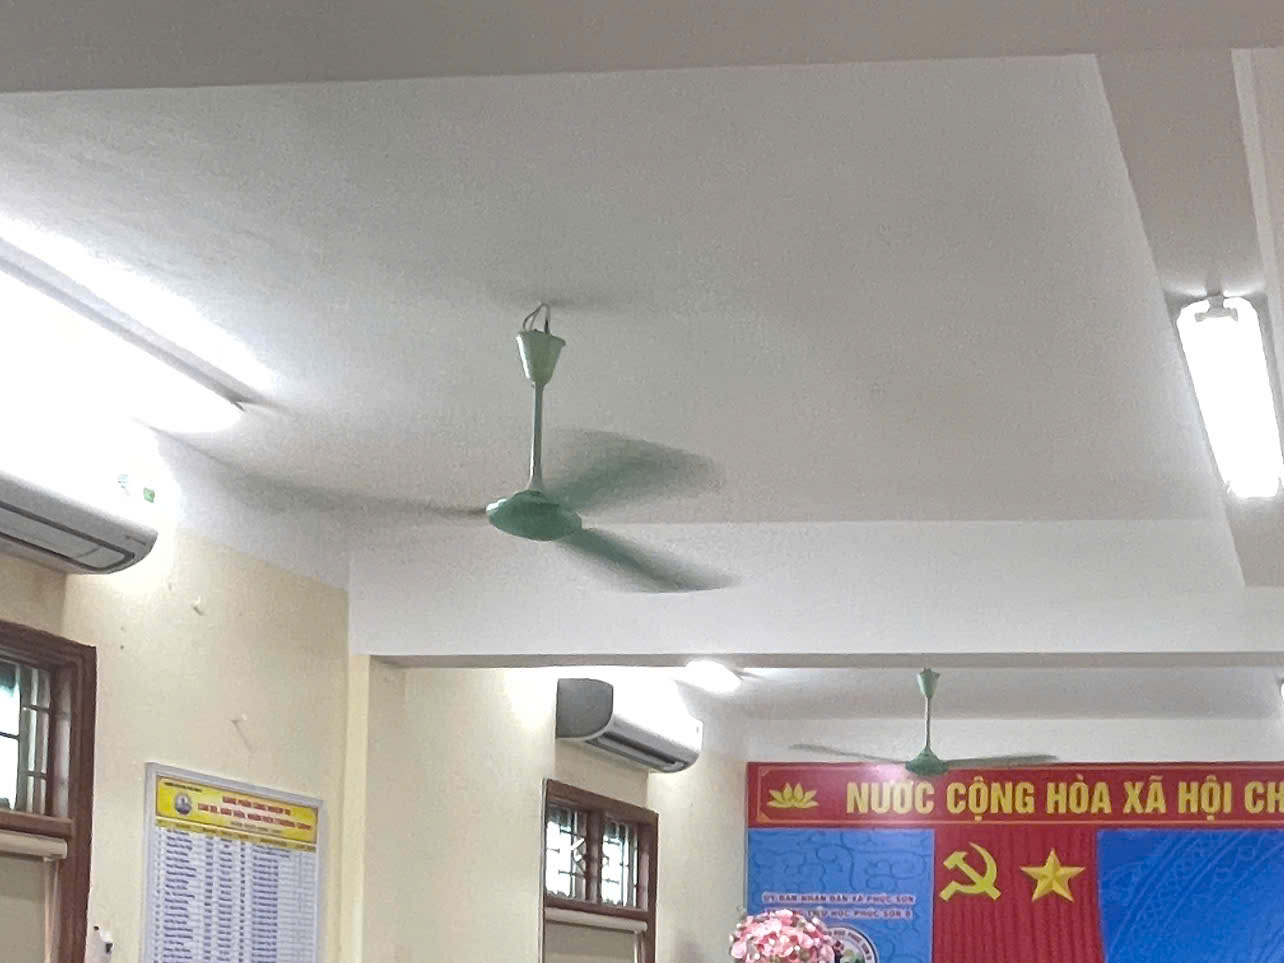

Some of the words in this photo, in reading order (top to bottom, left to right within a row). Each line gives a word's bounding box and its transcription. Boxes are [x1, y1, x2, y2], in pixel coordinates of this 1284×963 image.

[946, 775, 1035, 822] CỘNG
[1046, 773, 1112, 814] HÒA
[1122, 775, 1167, 814] XÃ
[1177, 775, 1232, 821] HỘI
